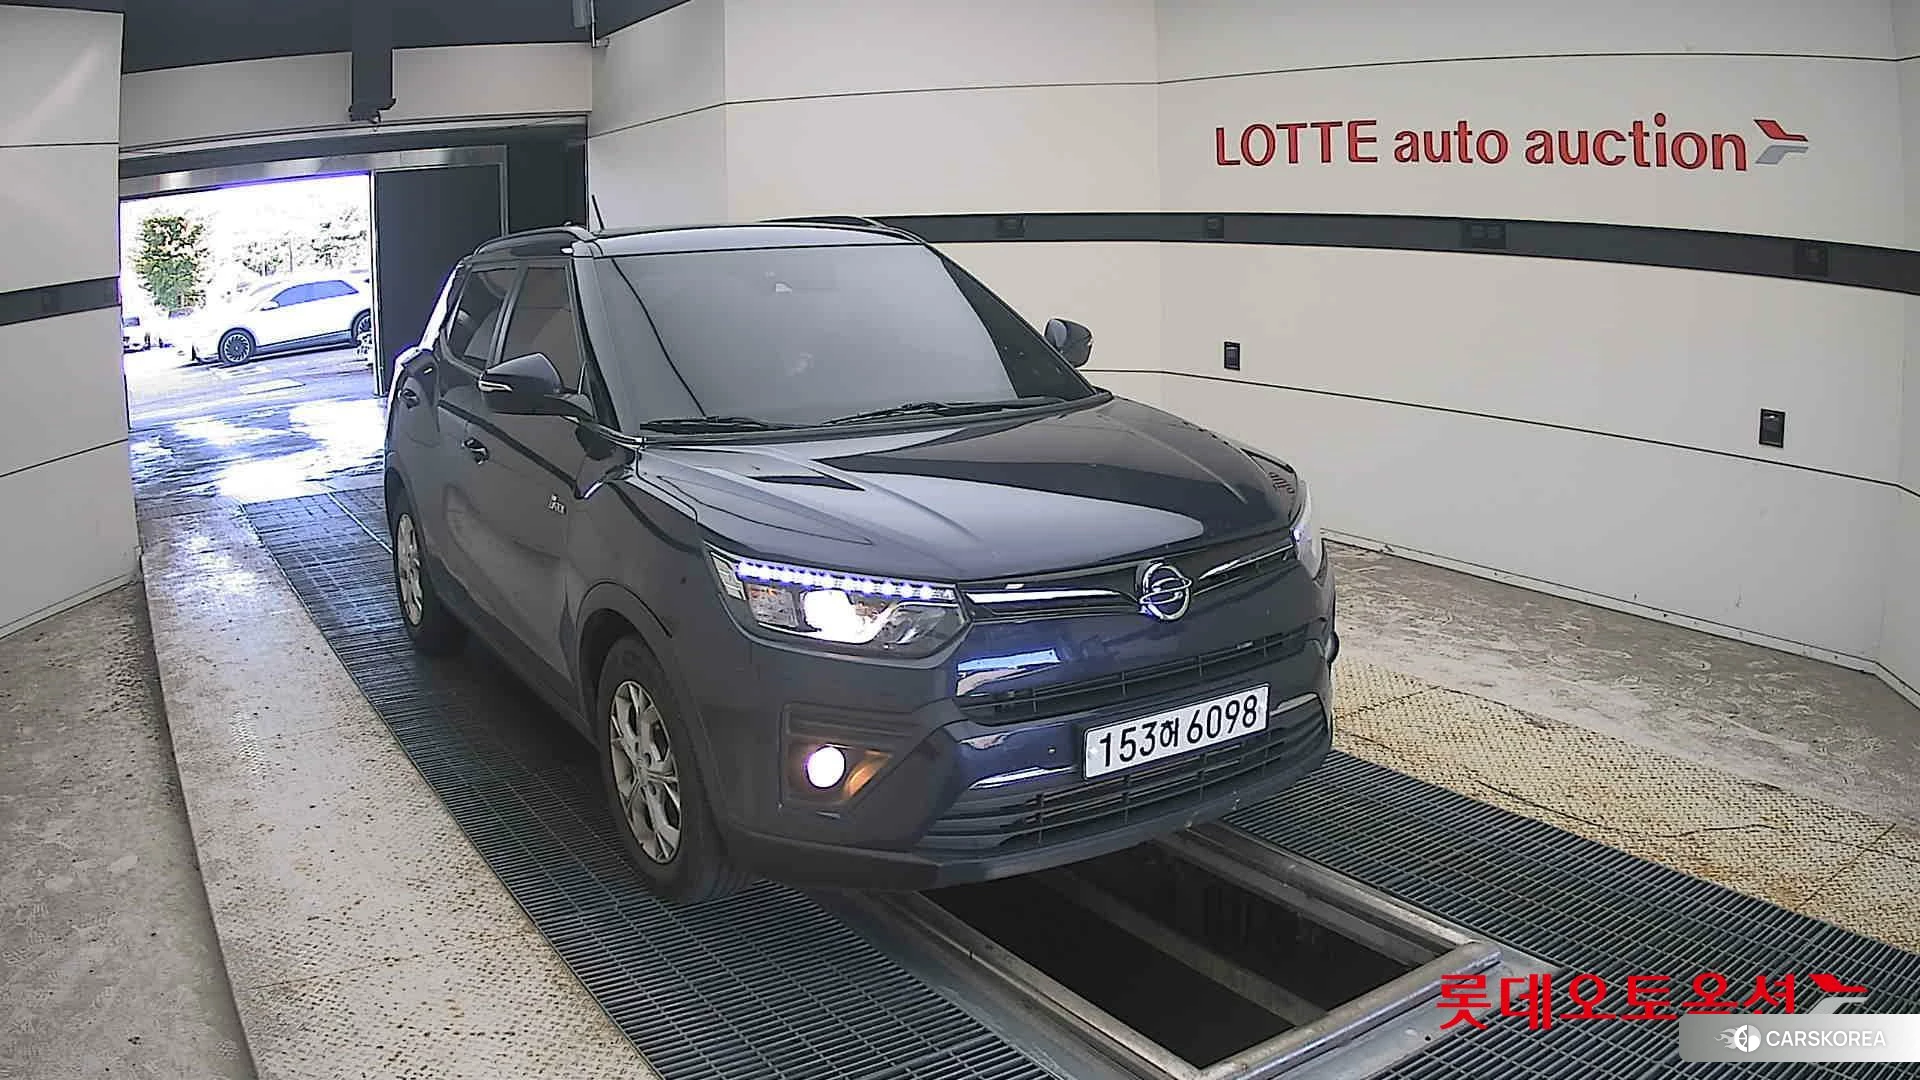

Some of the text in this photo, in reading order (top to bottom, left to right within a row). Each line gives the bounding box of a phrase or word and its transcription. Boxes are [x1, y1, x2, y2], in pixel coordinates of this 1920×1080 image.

[1215, 112, 1748, 171] LOTTE auto auction
[1186, 694, 1259, 745] 6098
